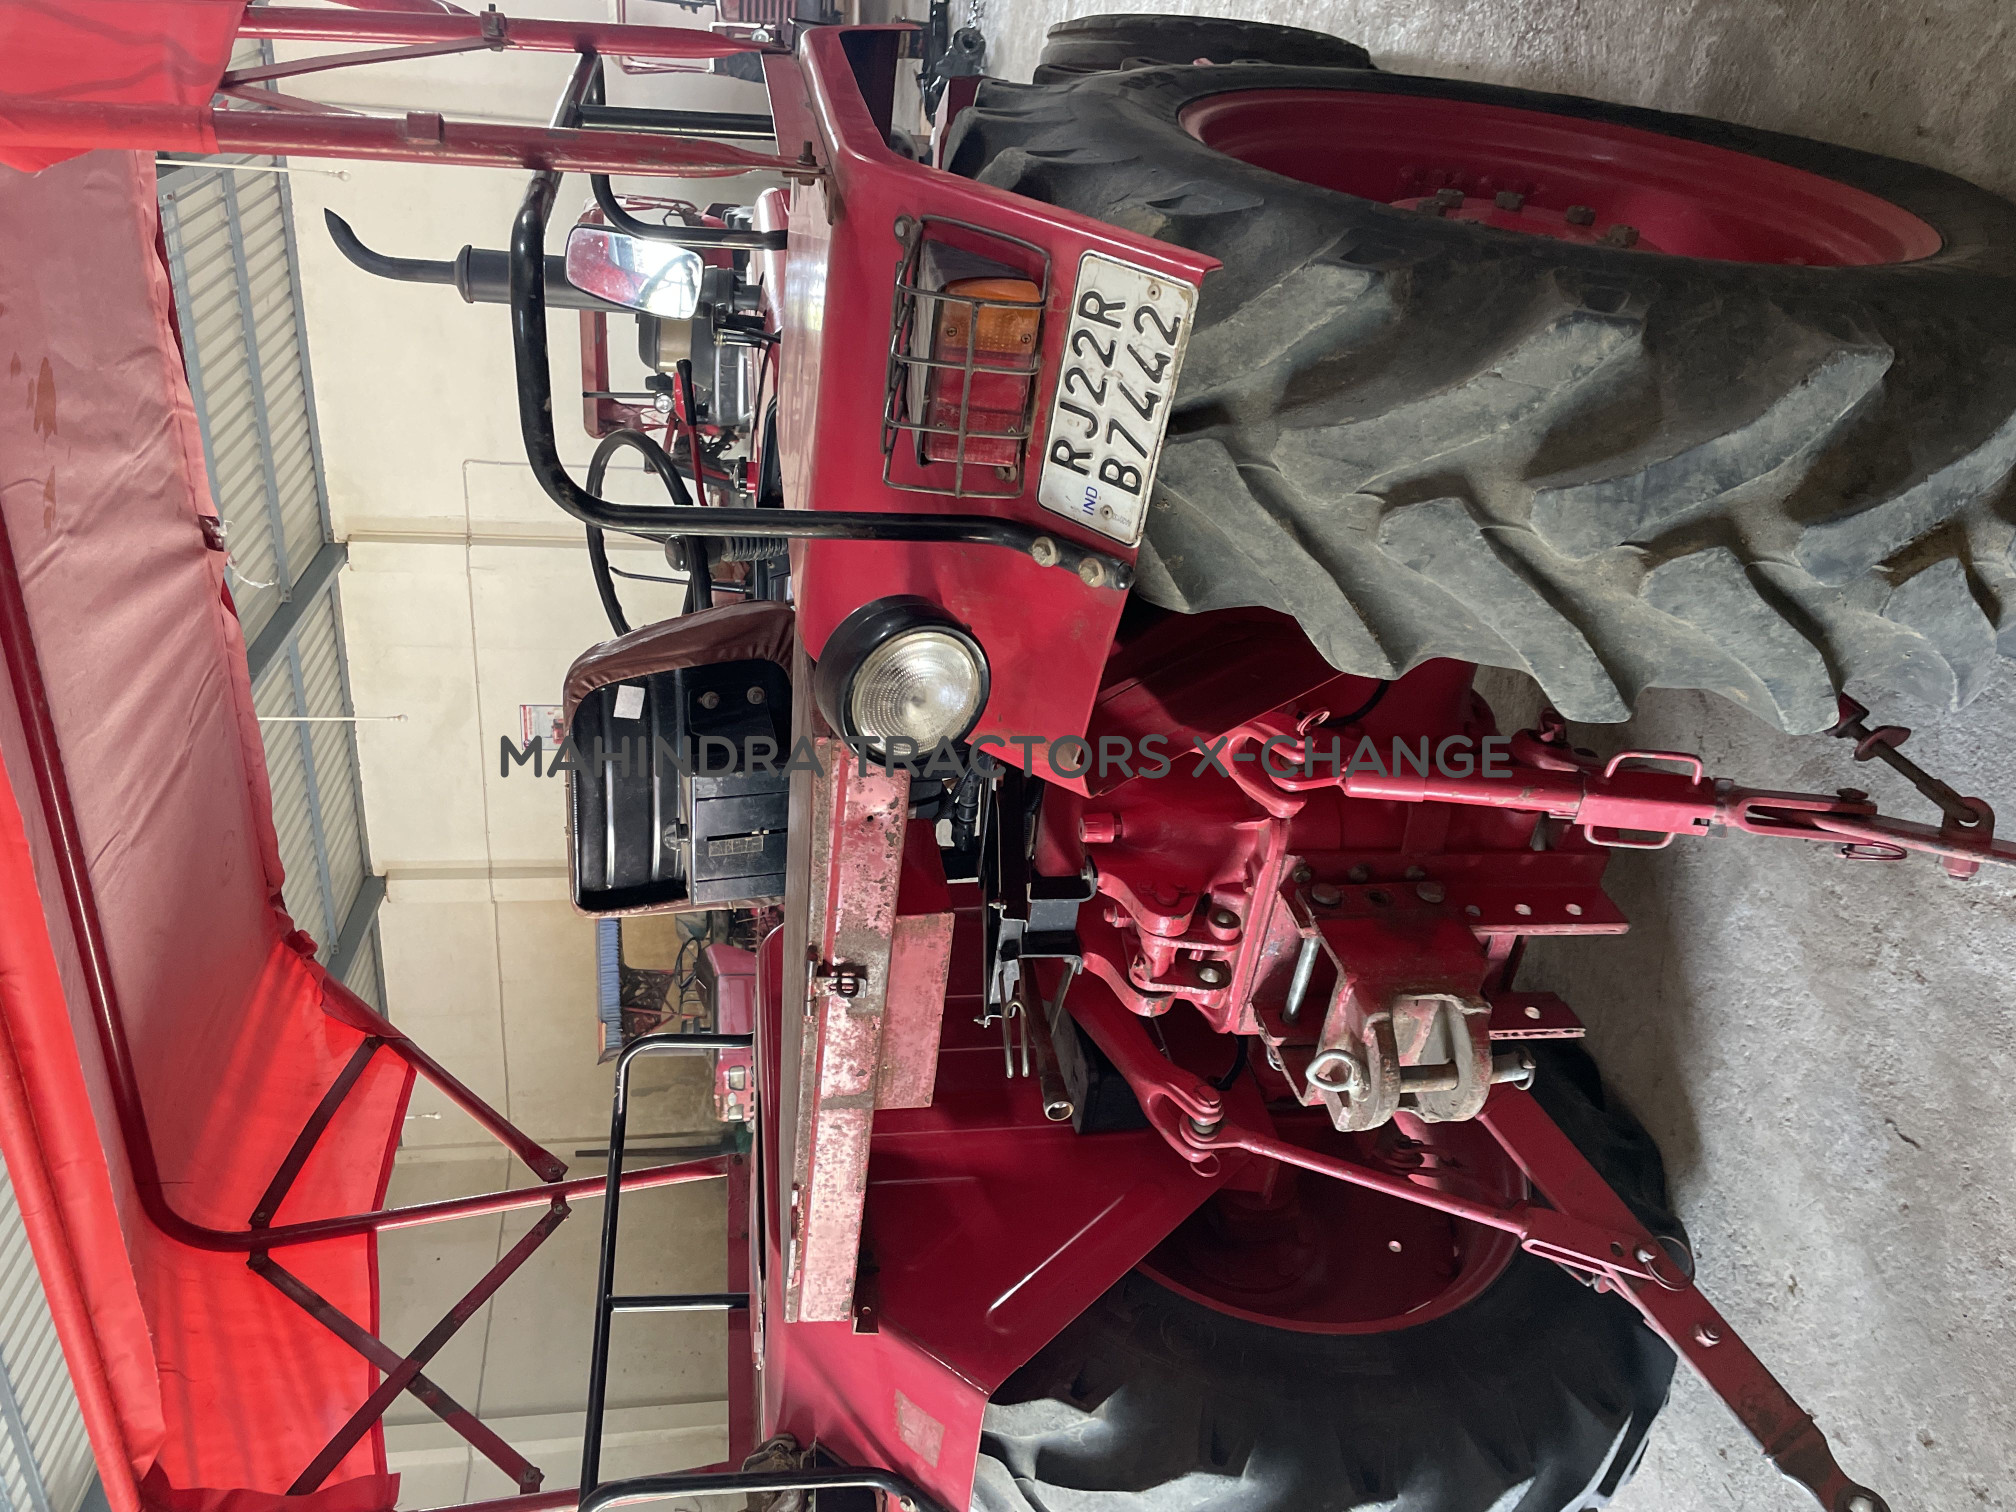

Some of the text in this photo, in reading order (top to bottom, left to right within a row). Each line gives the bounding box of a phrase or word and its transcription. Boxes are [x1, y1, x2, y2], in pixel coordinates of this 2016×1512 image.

[1050, 291, 1126, 476] RJ22R
[1100, 305, 1181, 496] B7442
[1082, 486, 1098, 515] IND
